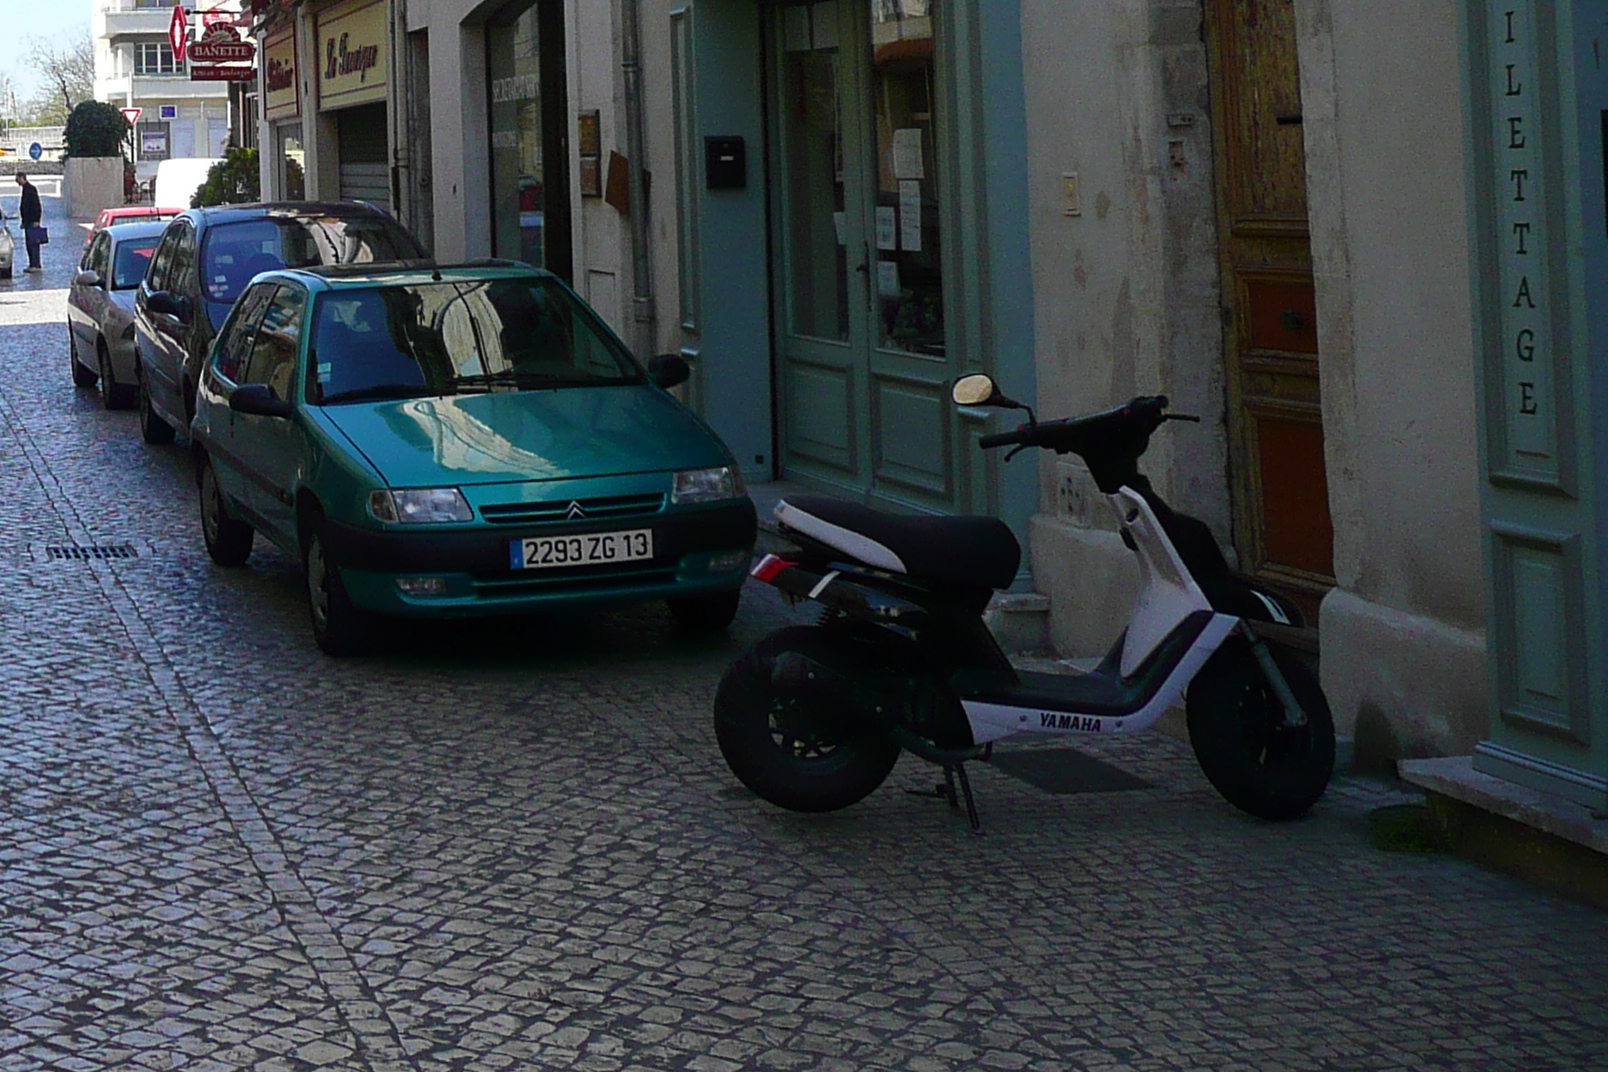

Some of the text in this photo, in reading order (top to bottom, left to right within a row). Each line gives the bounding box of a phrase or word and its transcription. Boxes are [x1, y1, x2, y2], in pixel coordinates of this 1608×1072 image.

[195, 46, 249, 57] BANETTE
[525, 533, 649, 565] 2293 ZG 13
[1039, 713, 1102, 732] YAMAHA
